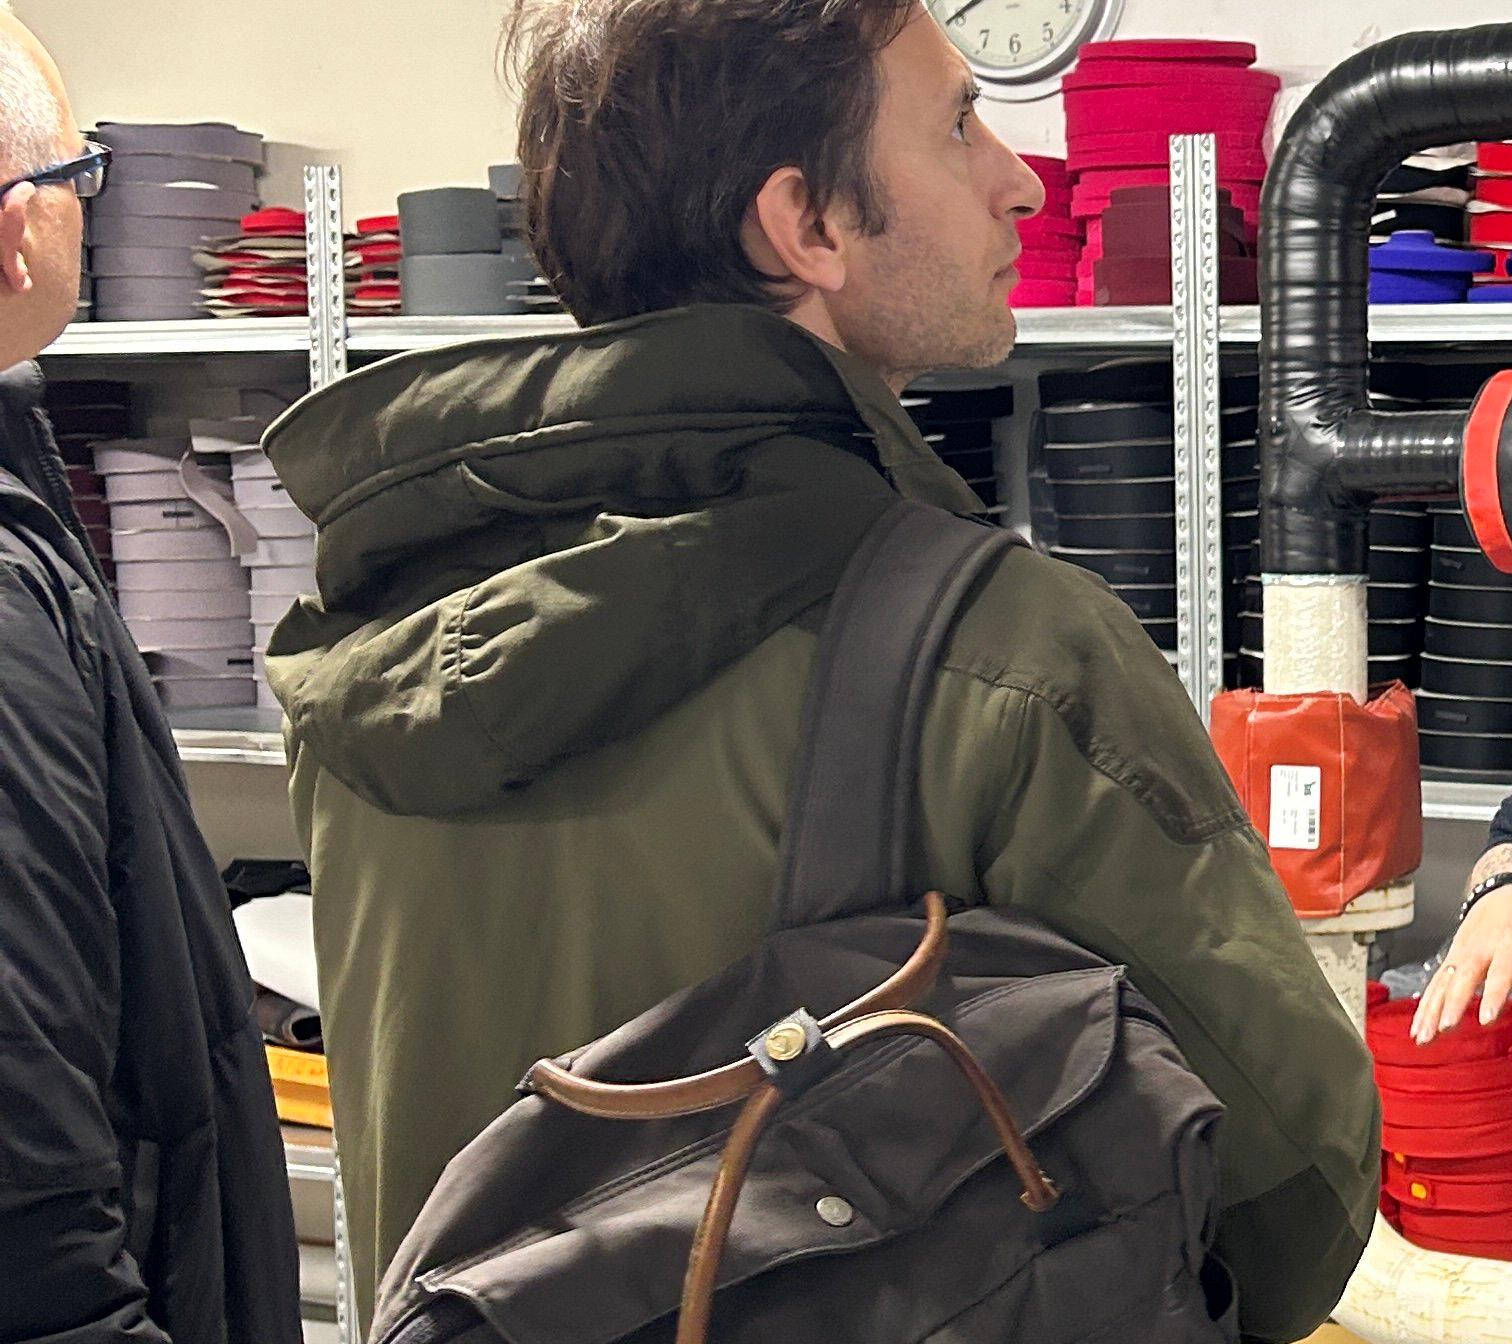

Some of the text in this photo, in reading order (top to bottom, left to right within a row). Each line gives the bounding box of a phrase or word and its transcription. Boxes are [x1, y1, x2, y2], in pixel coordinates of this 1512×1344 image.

[979, 29, 990, 50] 7
[1042, 22, 1054, 43] 5
[1009, 33, 1022, 55] 6
